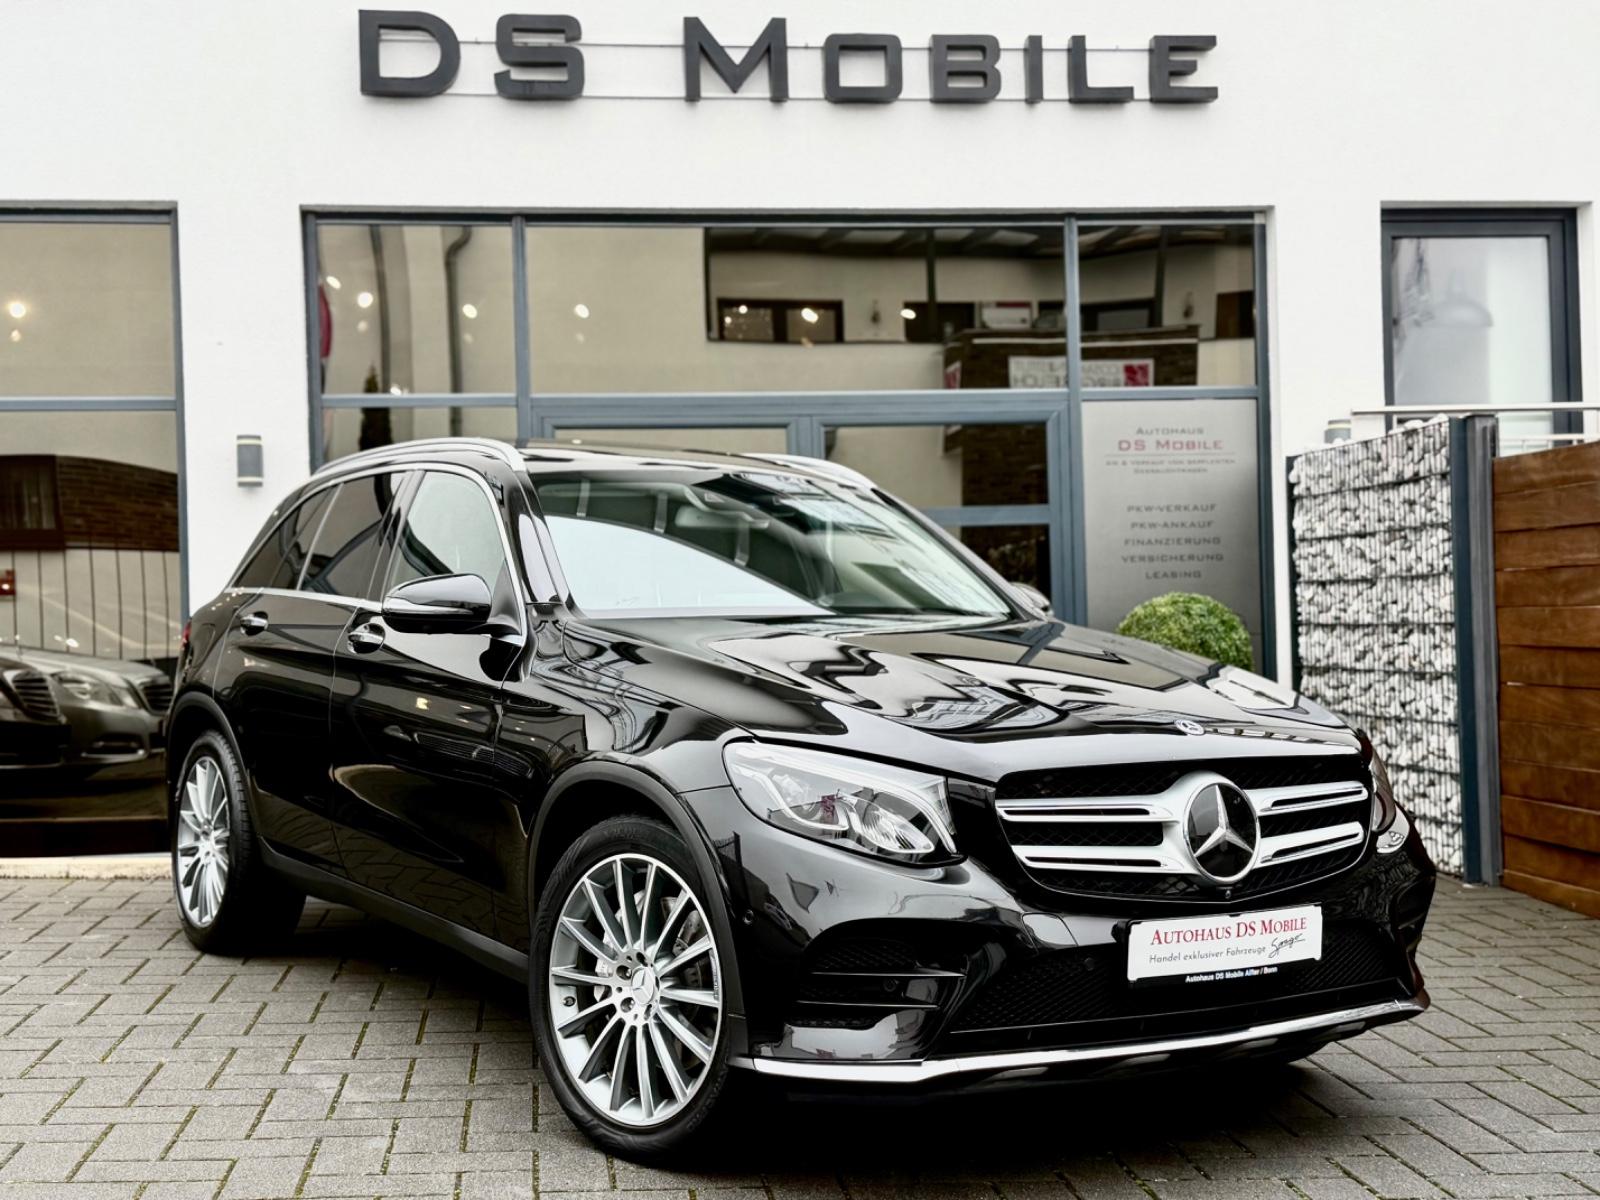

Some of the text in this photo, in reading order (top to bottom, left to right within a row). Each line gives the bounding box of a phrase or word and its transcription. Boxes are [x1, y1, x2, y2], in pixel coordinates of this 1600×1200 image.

[359, 9, 1219, 104] DS MOBILE
[1136, 427, 1204, 436] AUTOHAUS
[1118, 439, 1223, 451] DS MOBILE
[1127, 503, 1217, 513] PKW-VERKAUF
[1130, 520, 1214, 529] PKW-ANKAUF
[1124, 536, 1221, 546] FINANZIERUNG
[1121, 553, 1224, 563] VERSICHERUNG
[1145, 570, 1202, 579] LEASING
[1150, 916, 1307, 945] AUTOHAUS DS MOBILE
[1149, 946, 1266, 963] Handel exklusiver Fahrzeuge
[1215, 972, 1224, 980] DS
